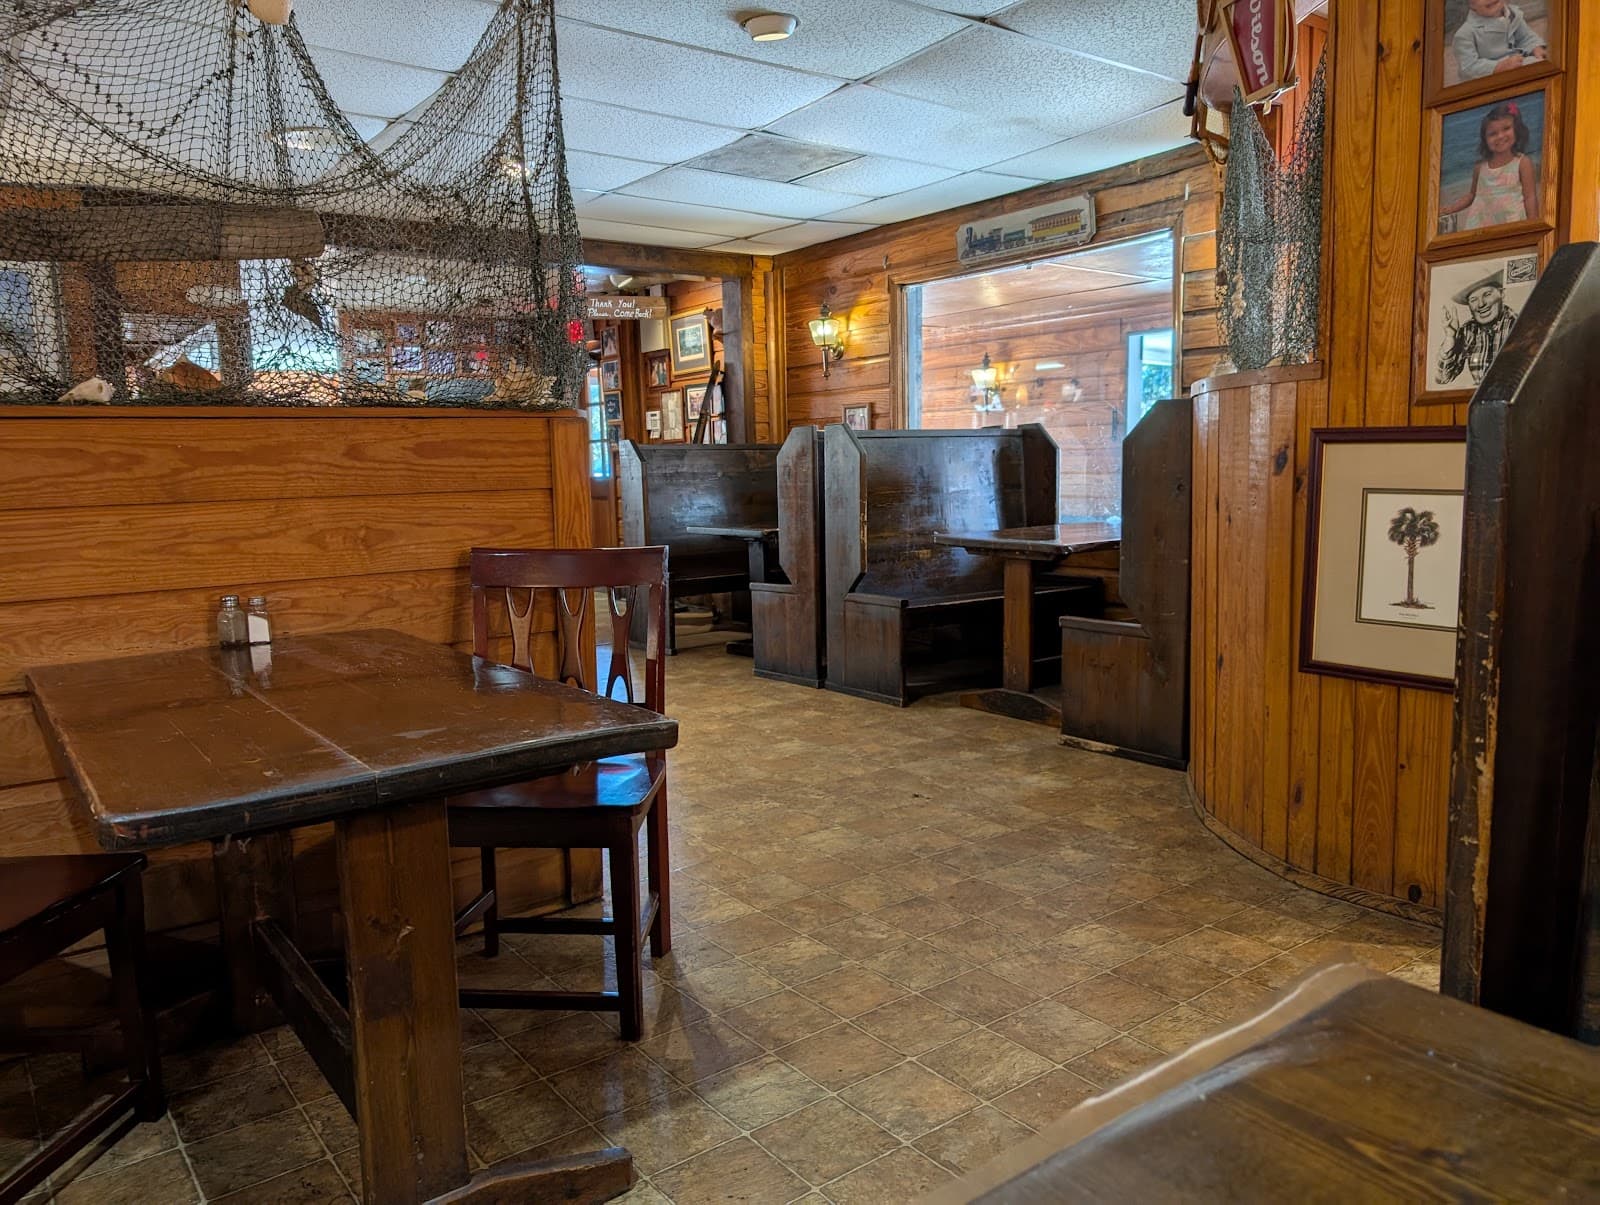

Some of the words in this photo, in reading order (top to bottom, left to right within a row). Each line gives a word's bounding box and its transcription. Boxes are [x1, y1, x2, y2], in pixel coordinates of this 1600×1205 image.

[590, 298, 613, 308] Thank
[618, 298, 636, 308] You!
[613, 308, 634, 318] Come
[634, 308, 653, 319] Back!
